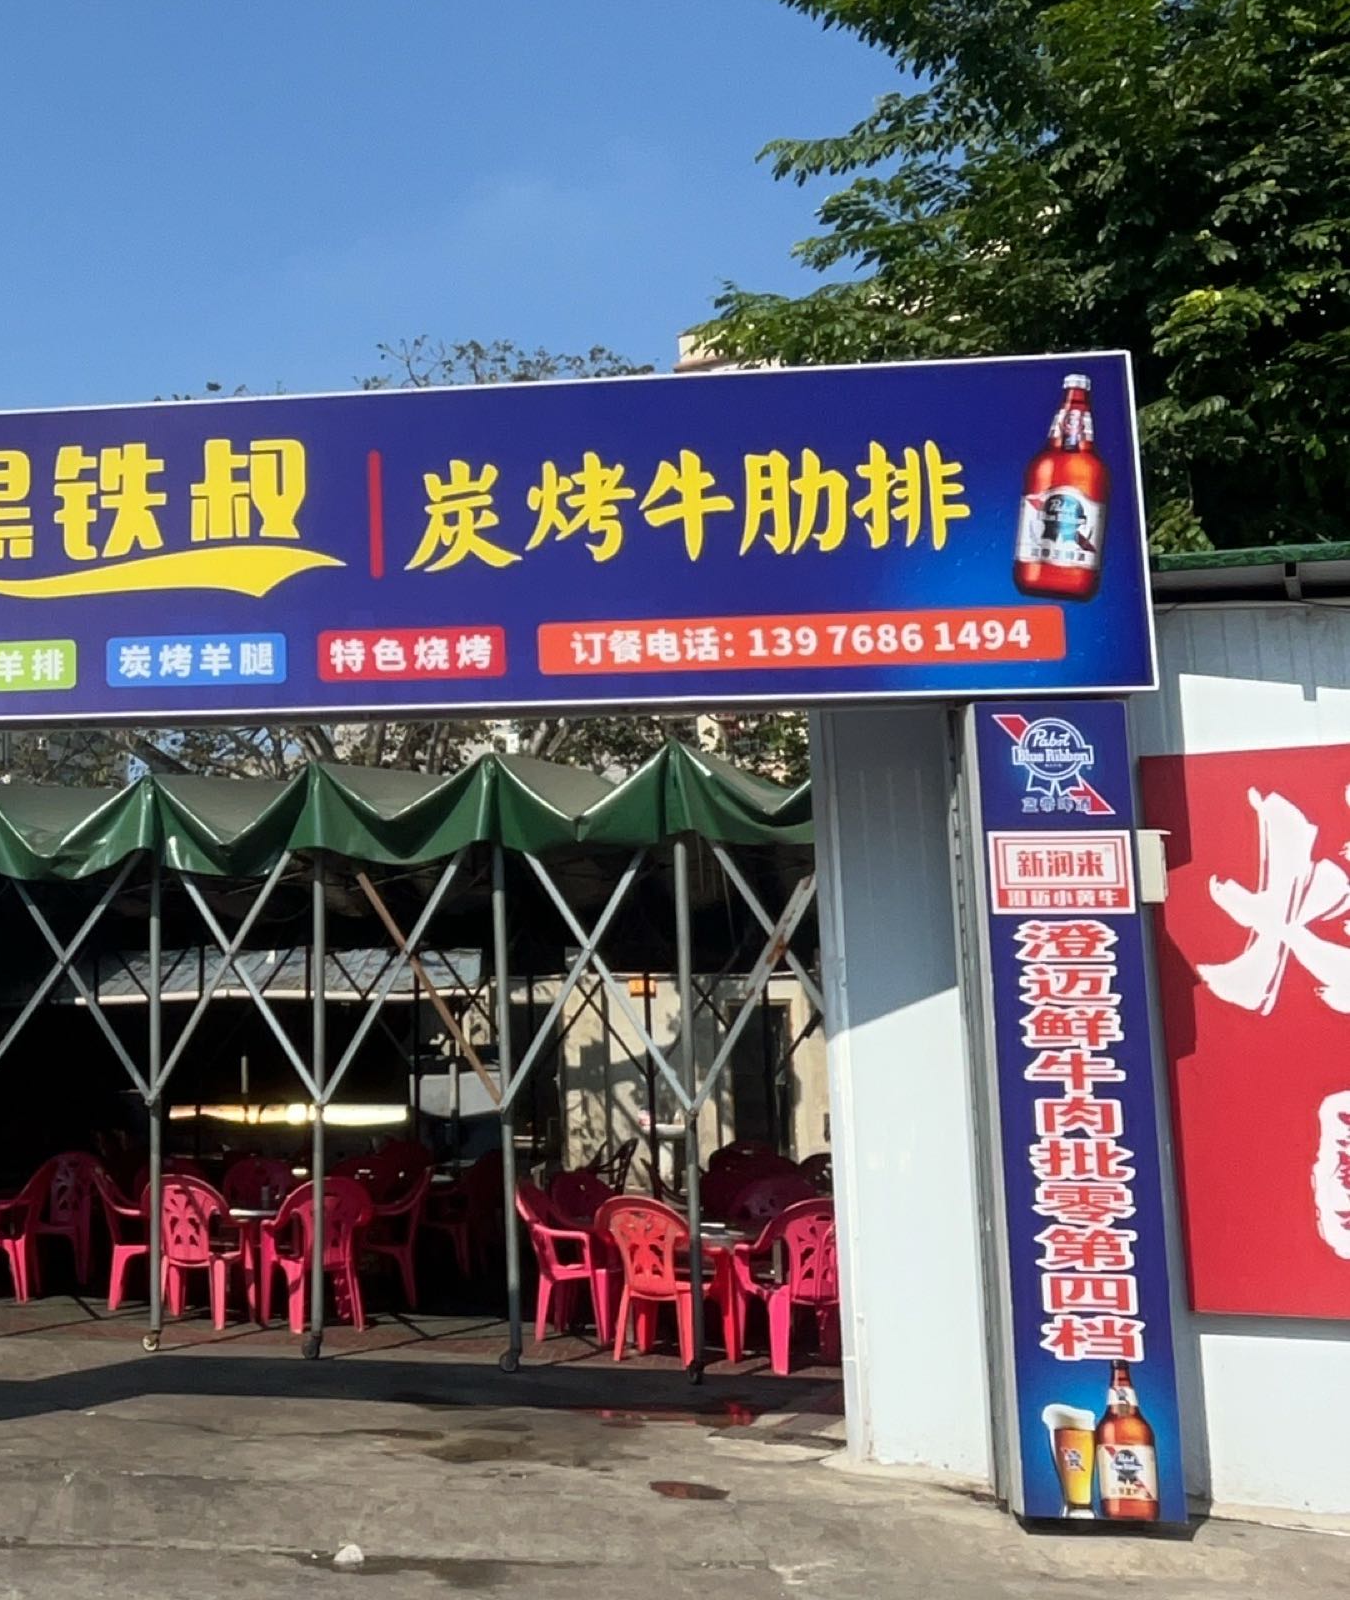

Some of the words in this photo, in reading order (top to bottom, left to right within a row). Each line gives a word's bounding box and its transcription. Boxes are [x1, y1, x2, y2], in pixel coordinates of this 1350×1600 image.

[404, 440, 970, 572] 炭烤牛肋排
[119, 641, 274, 678] 炭烤羊腿
[330, 635, 492, 674] 特色烧烤
[1017, 850, 1104, 877] 新润来
[1013, 920, 1145, 1362] 澄迈鲜牛肉批零第四档
